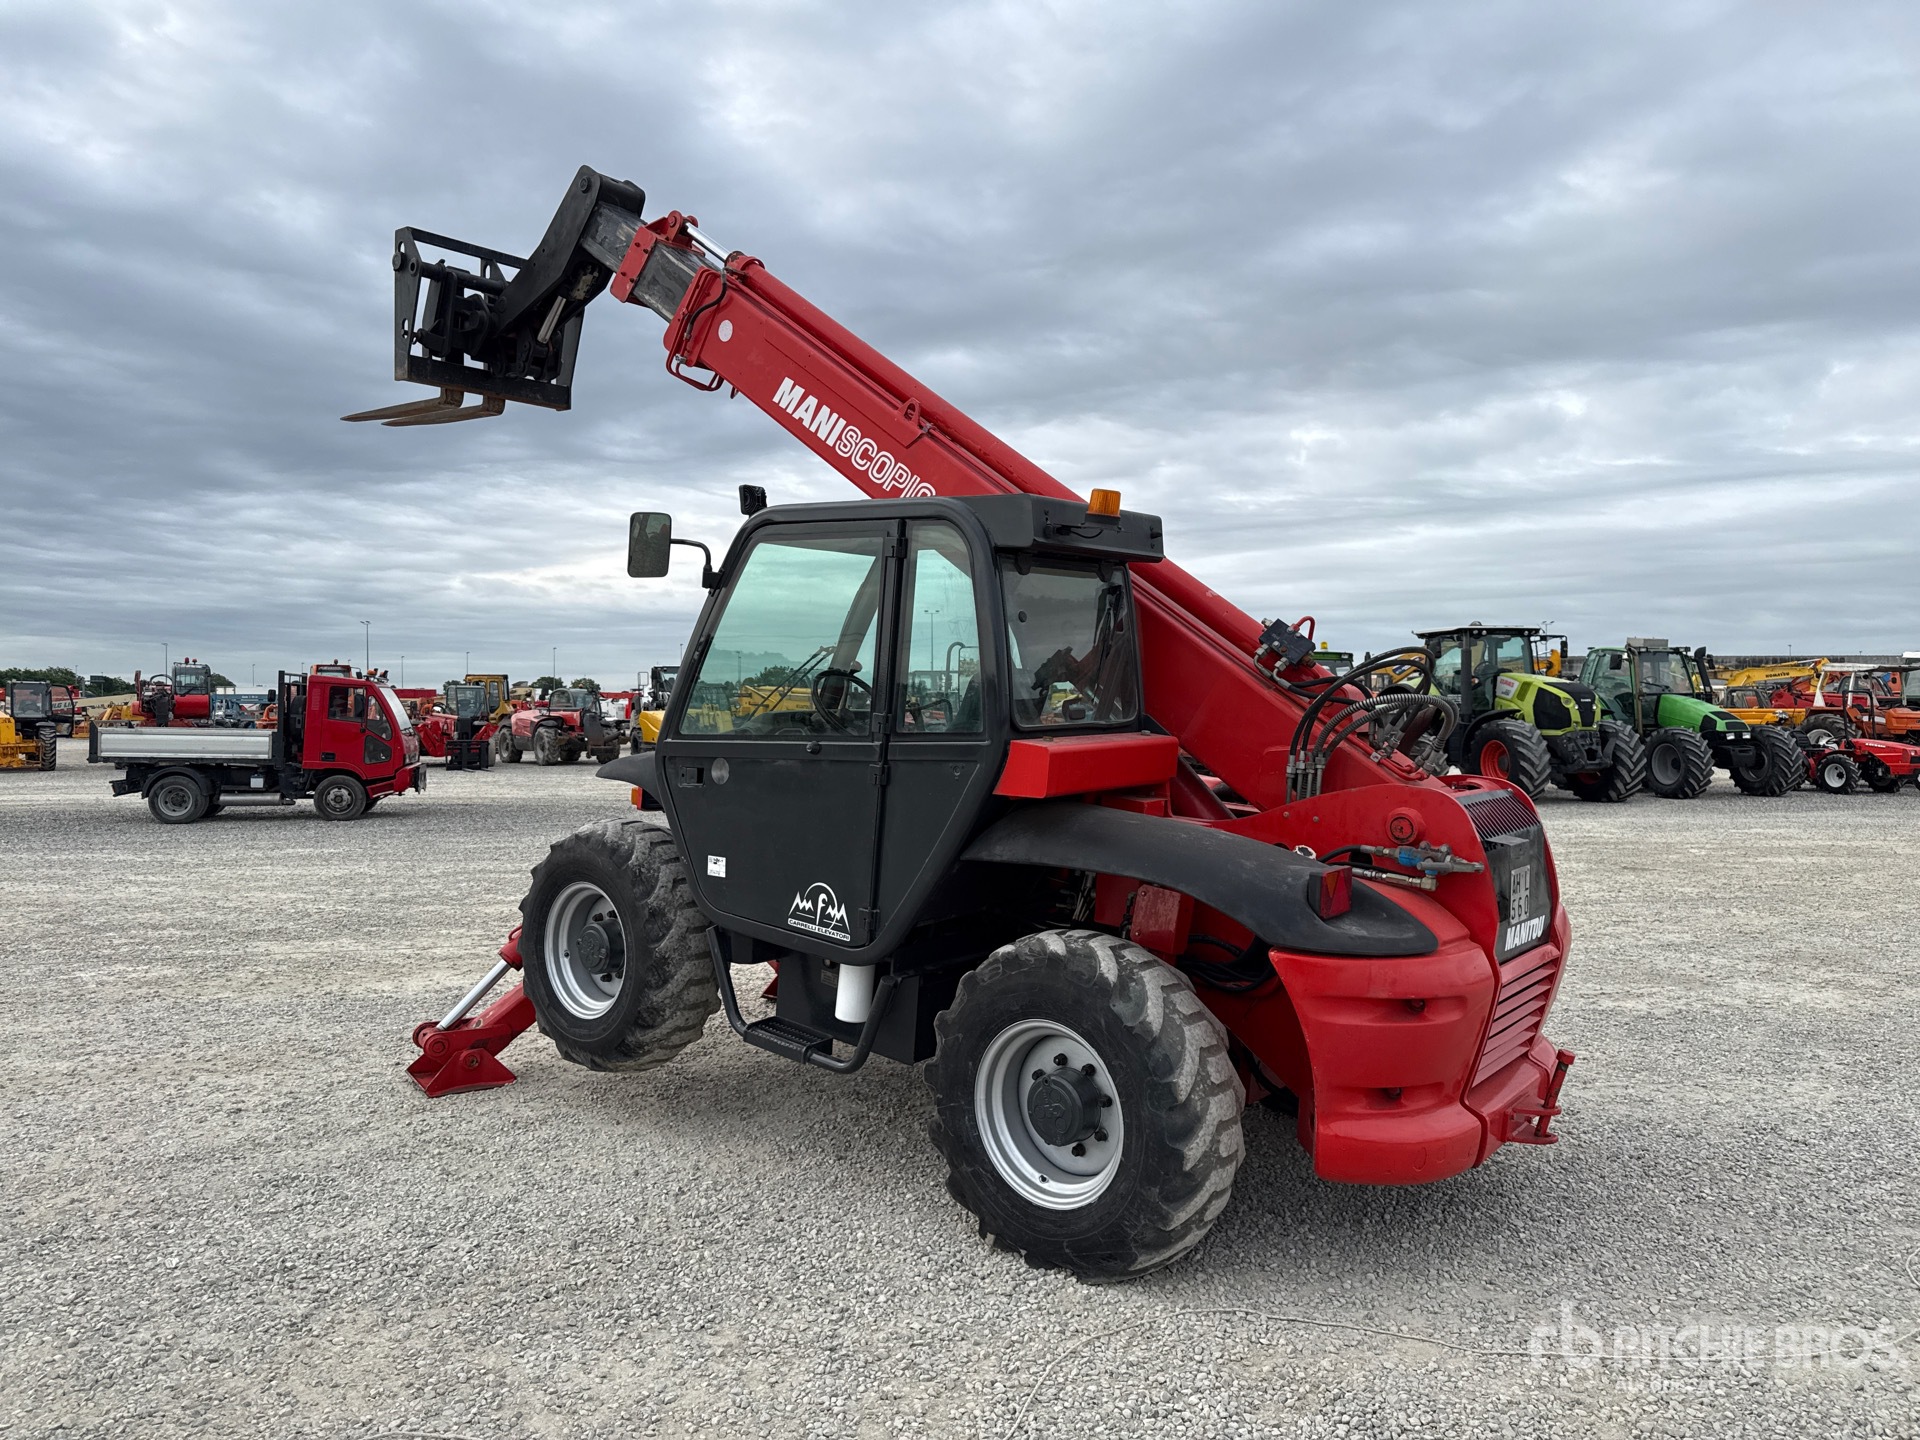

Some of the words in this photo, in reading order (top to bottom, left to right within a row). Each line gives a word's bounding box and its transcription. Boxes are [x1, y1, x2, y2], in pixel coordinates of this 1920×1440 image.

[1511, 894, 1529, 920] 560
[788, 919, 817, 931] CARRELLI
[817, 927, 850, 940] ELEVATORI
[1504, 915, 1546, 951] MANITOU
